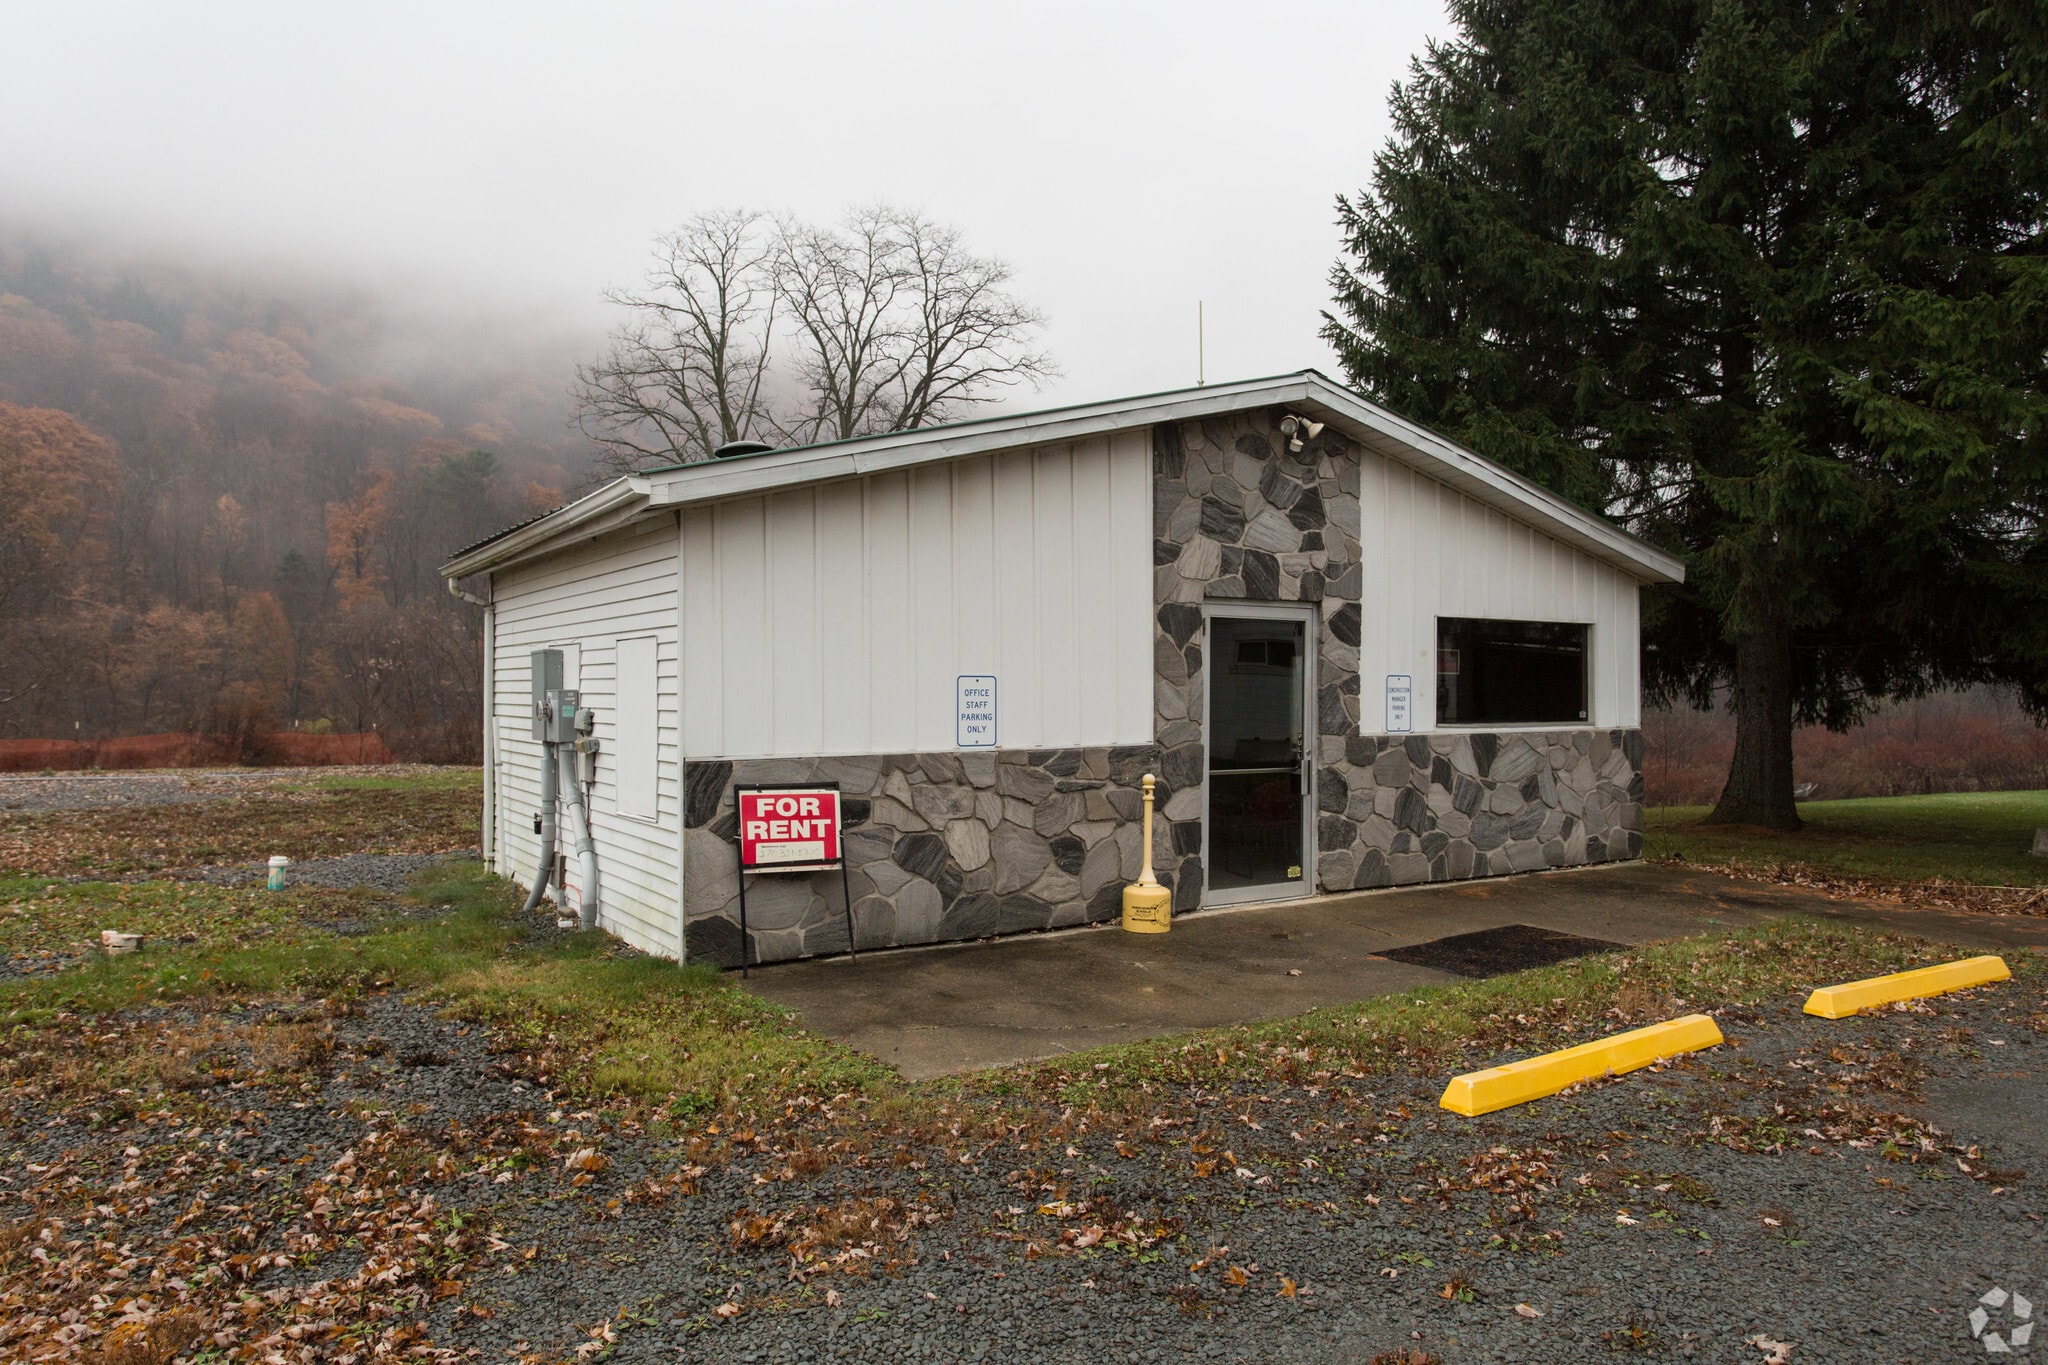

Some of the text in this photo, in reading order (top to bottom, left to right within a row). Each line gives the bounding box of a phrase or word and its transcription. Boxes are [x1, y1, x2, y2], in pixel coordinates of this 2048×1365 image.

[964, 688, 990, 697] OFFICE
[965, 701, 988, 709] STAFF
[961, 713, 993, 721] PARKING
[966, 725, 987, 733] ONLY
[756, 797, 820, 818] FOR
[746, 819, 832, 840] RENT
